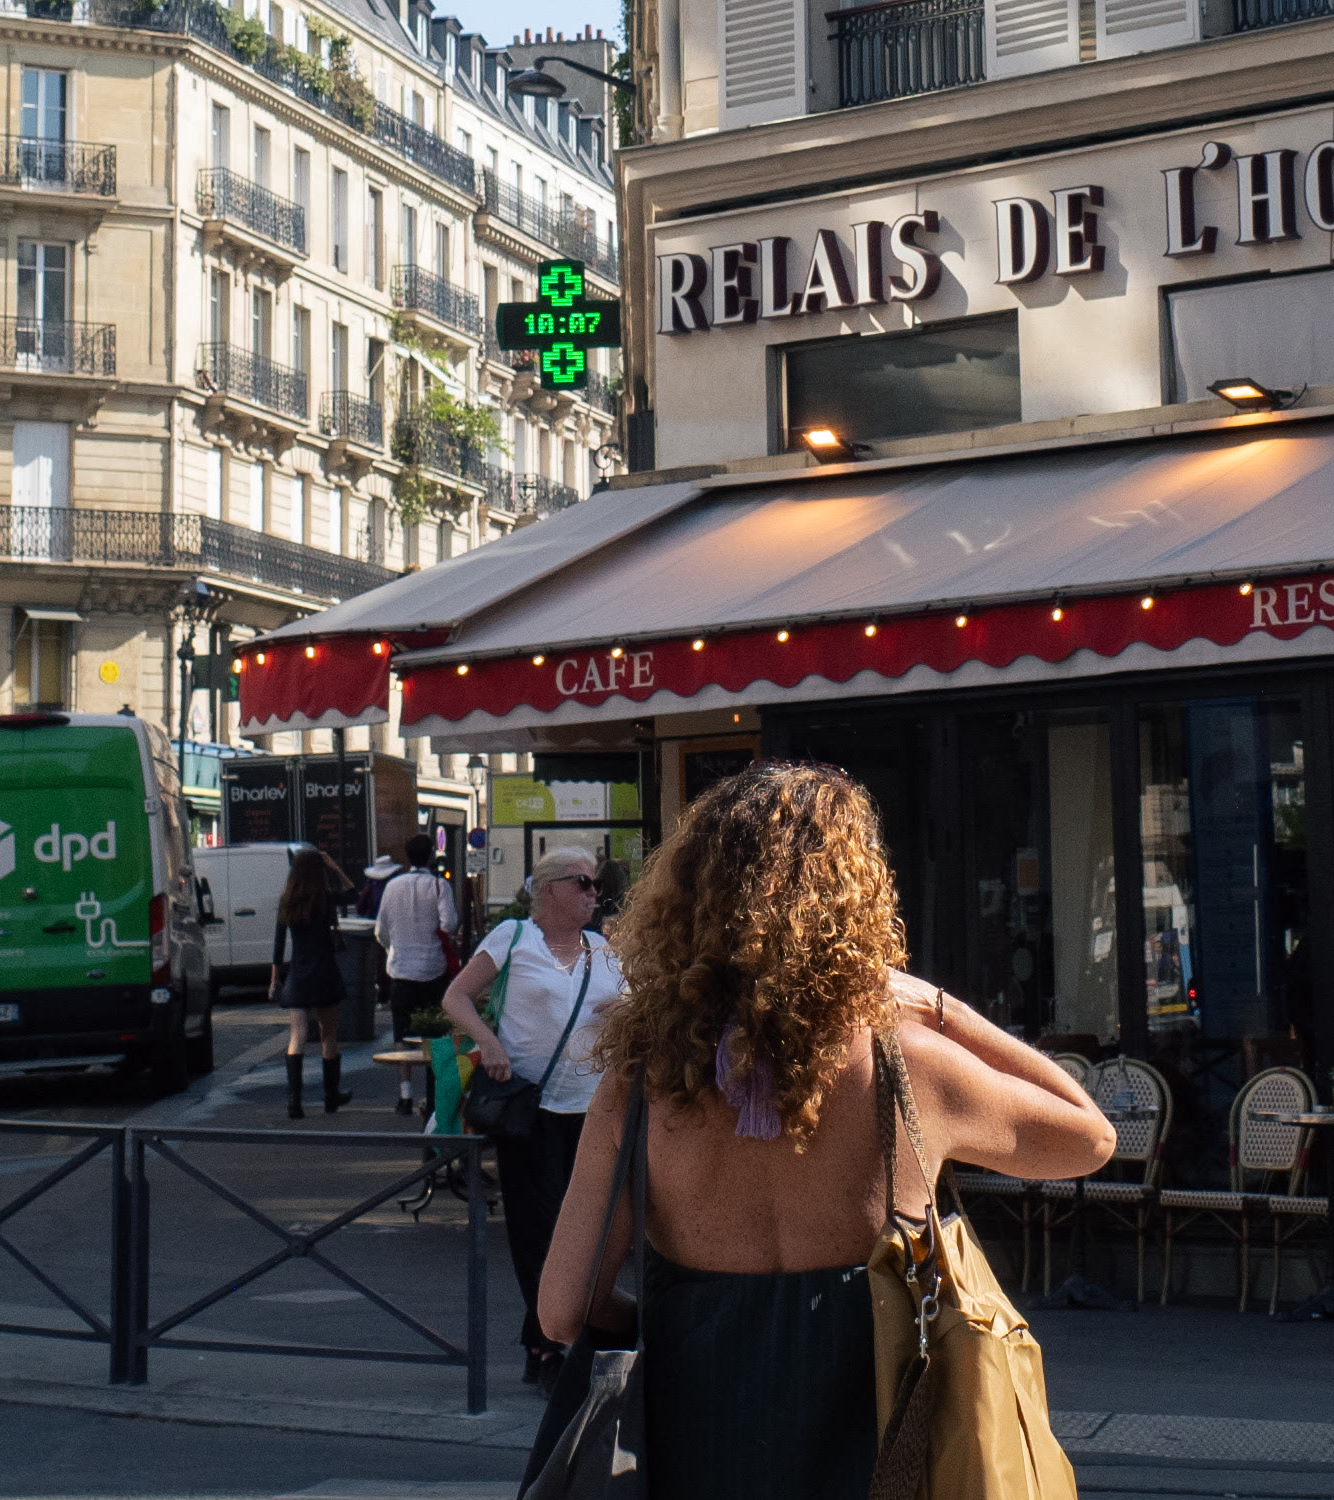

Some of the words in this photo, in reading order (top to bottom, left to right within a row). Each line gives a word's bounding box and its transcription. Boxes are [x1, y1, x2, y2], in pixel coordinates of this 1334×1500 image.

[657, 210, 939, 335] RELAIS
[993, 184, 1105, 286] DE
[524, 312, 601, 336] 10:07
[555, 651, 655, 698] CAFE
[305, 782, 362, 799] Bharev
[33, 819, 117, 873] dpd
